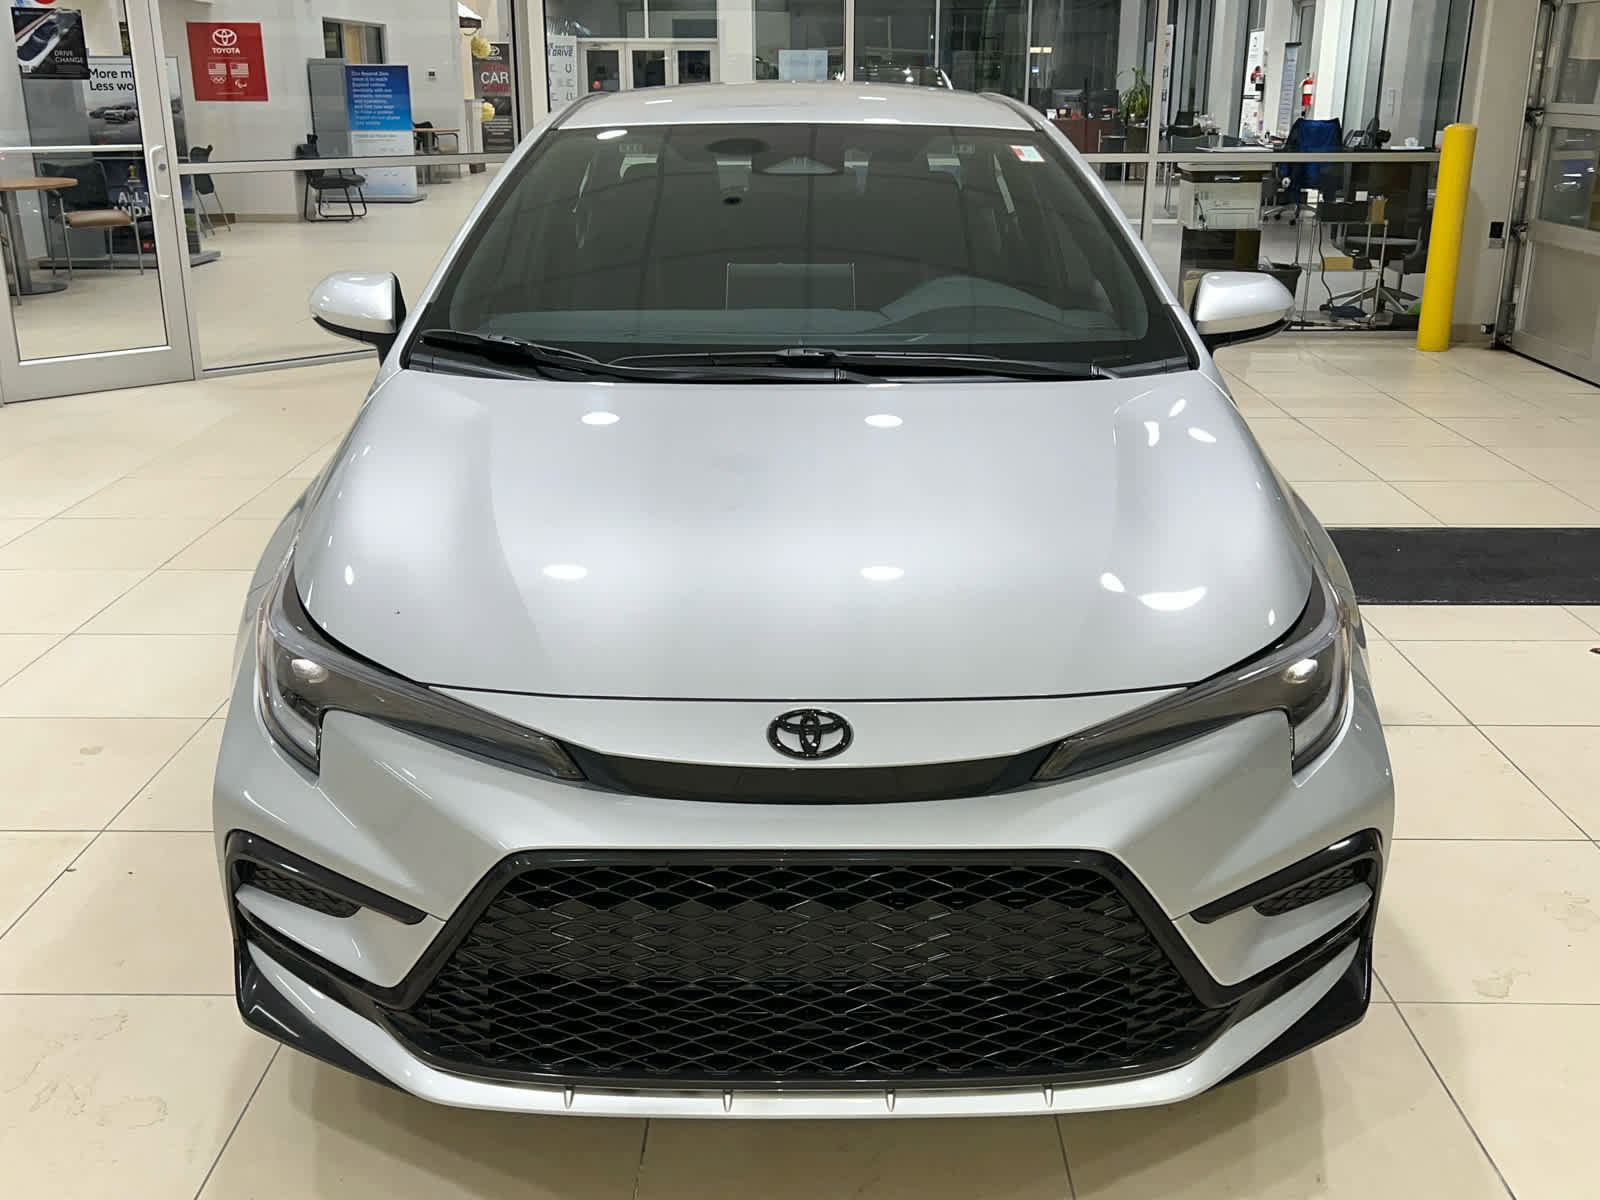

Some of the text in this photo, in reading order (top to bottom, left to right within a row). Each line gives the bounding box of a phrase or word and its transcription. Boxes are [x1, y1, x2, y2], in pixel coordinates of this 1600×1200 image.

[88, 68, 118, 79] More
[480, 71, 509, 84] CAR
[90, 80, 114, 91] Less
